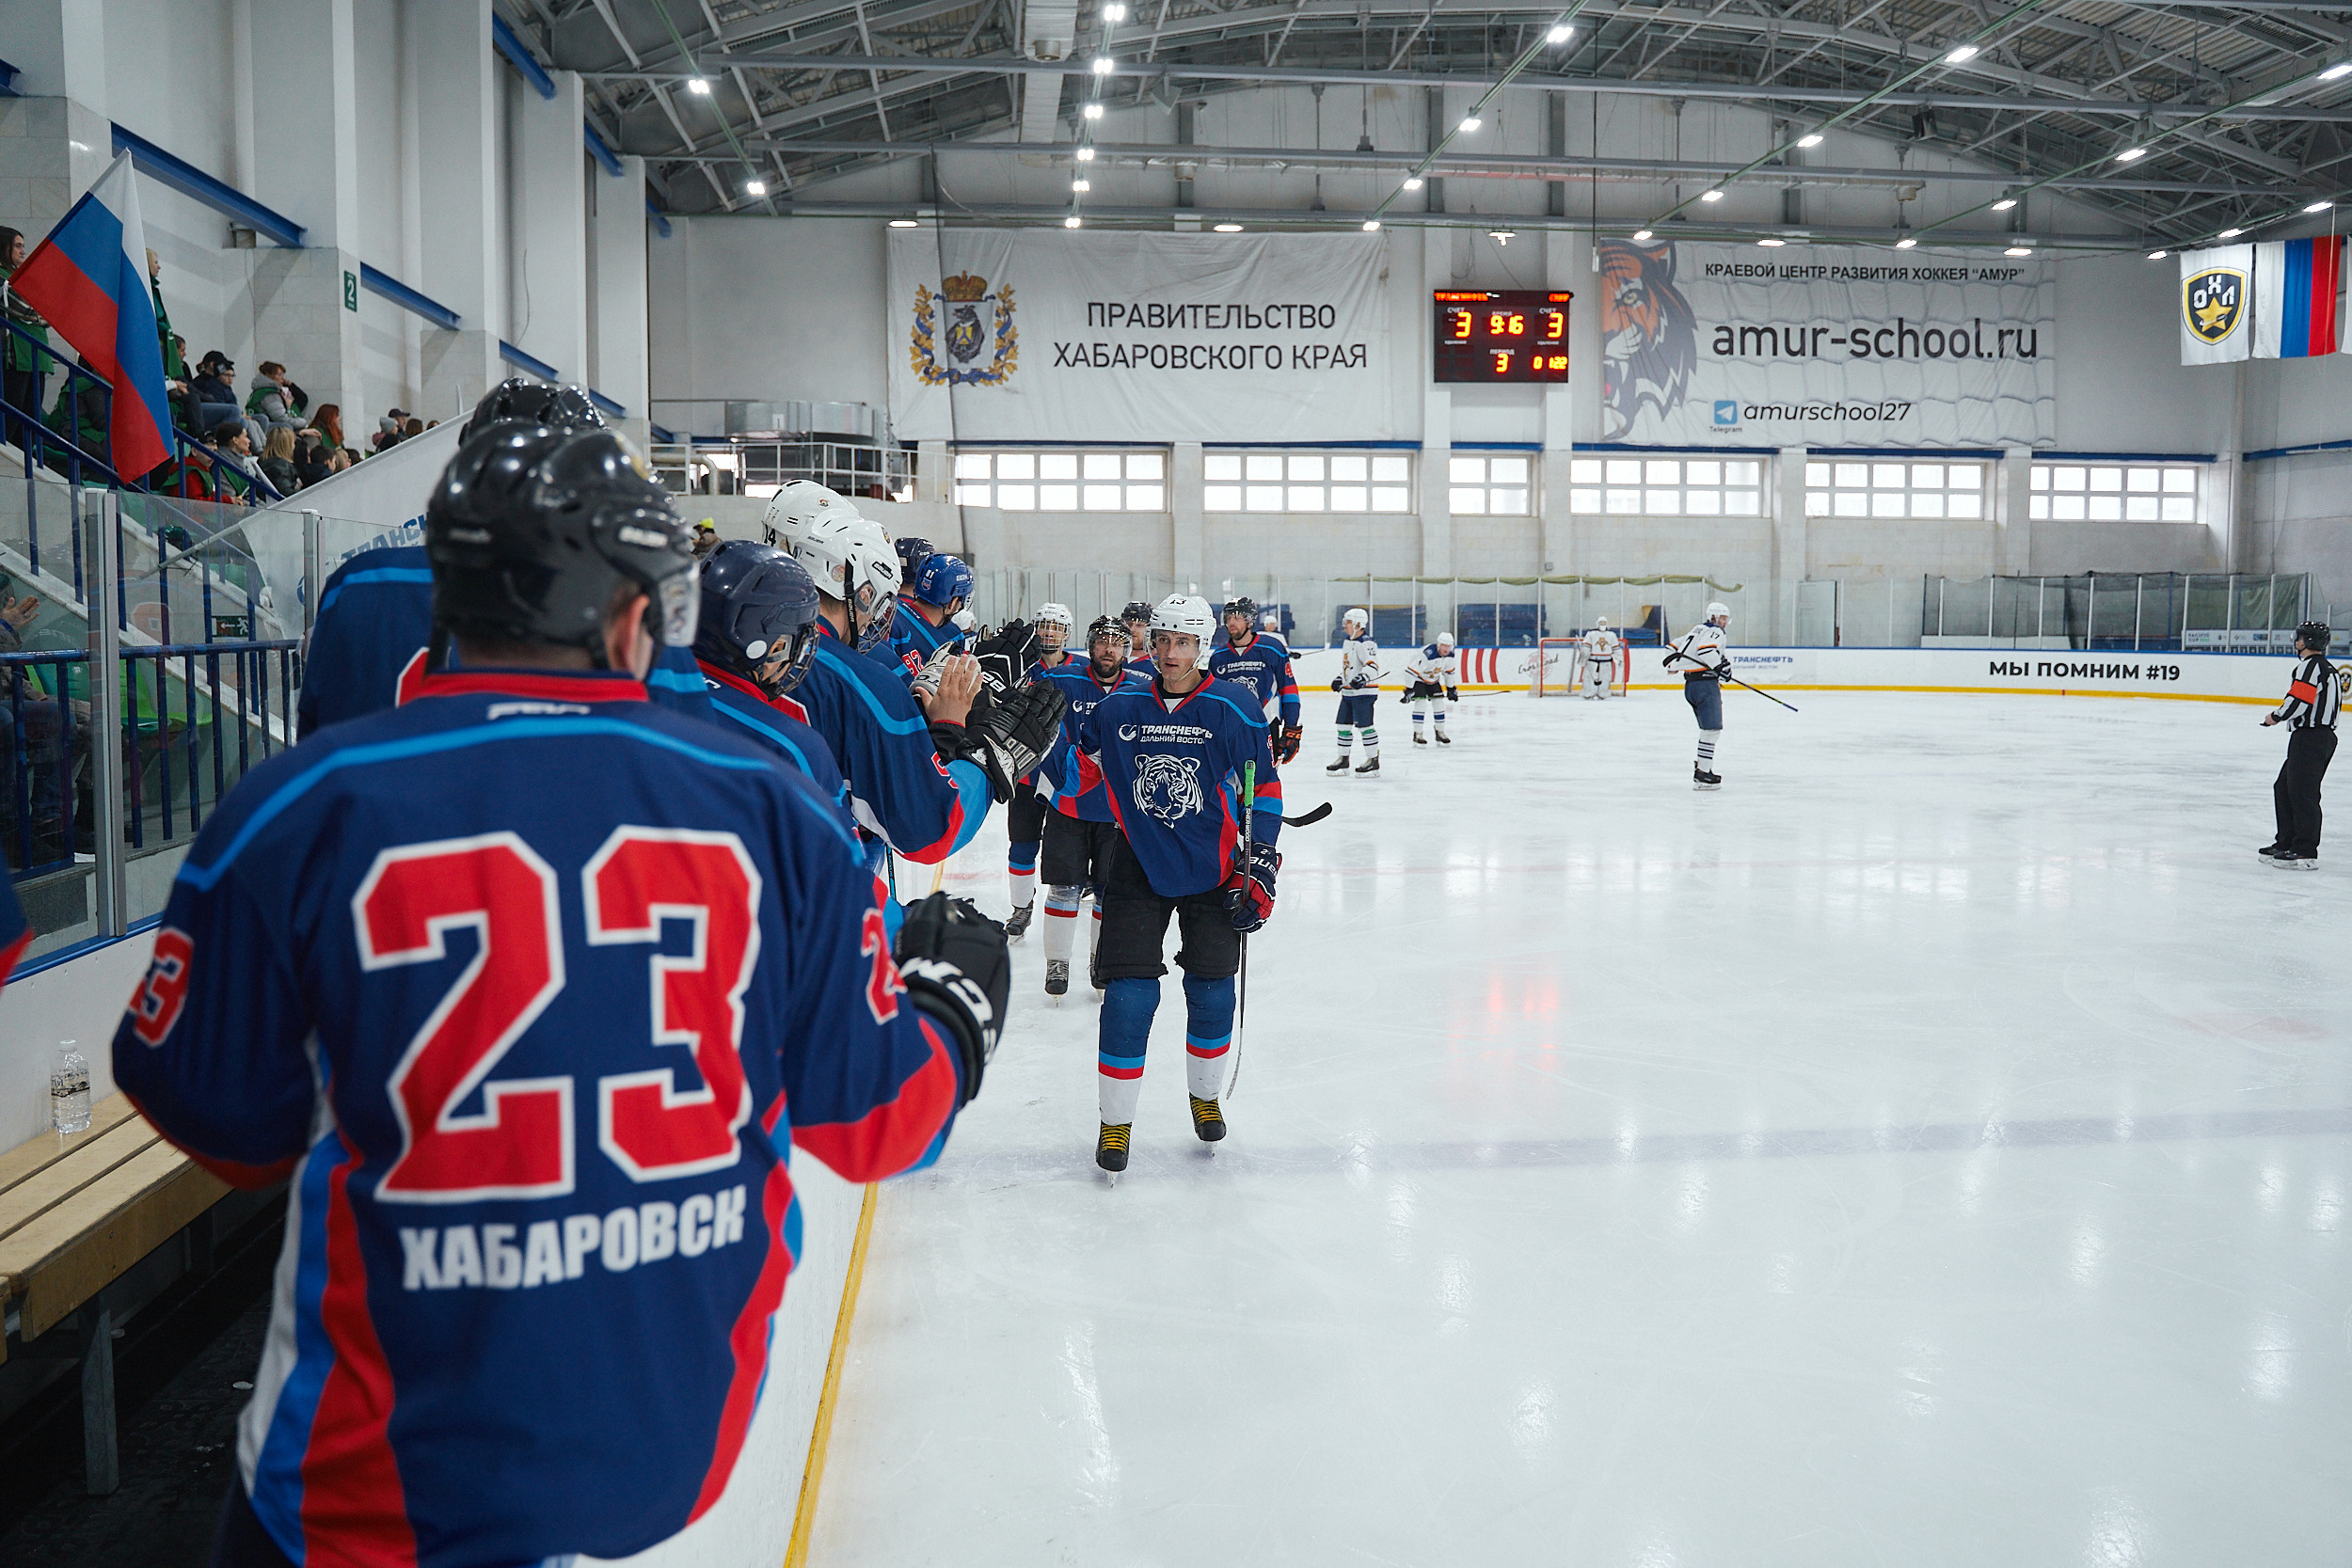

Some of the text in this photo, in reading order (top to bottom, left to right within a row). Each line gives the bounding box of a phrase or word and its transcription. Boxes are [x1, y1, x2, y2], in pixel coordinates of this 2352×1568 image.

[1706, 262, 1775, 277] КРАЕВОЙ
[1780, 264, 1827, 280] ЦЕНТР
[1832, 266, 1908, 279] РАЗВИТИЯ
[1913, 267, 1968, 280] ХОККЕЯ
[347, 278, 355, 302] 2
[1088, 302, 1336, 329] ПРАВИТЕЛЬСТВО
[1455, 311, 1472, 338] 3
[1547, 312, 1564, 338] 3
[1712, 317, 2037, 358] amur-school.ru
[1054, 341, 1367, 370] ХАБАРОВСКОГО КРАЯ
[1496, 353, 1509, 372] 3
[1743, 402, 1912, 420] amurschool27
[1989, 661, 2181, 681] МЫ ПОМНИМ #19
[1140, 734, 1205, 744] ДАЛЬНИЙ ВОСТО
[352, 824, 762, 1204] 23
[399, 1184, 747, 1291] ХАБАРОВСК
